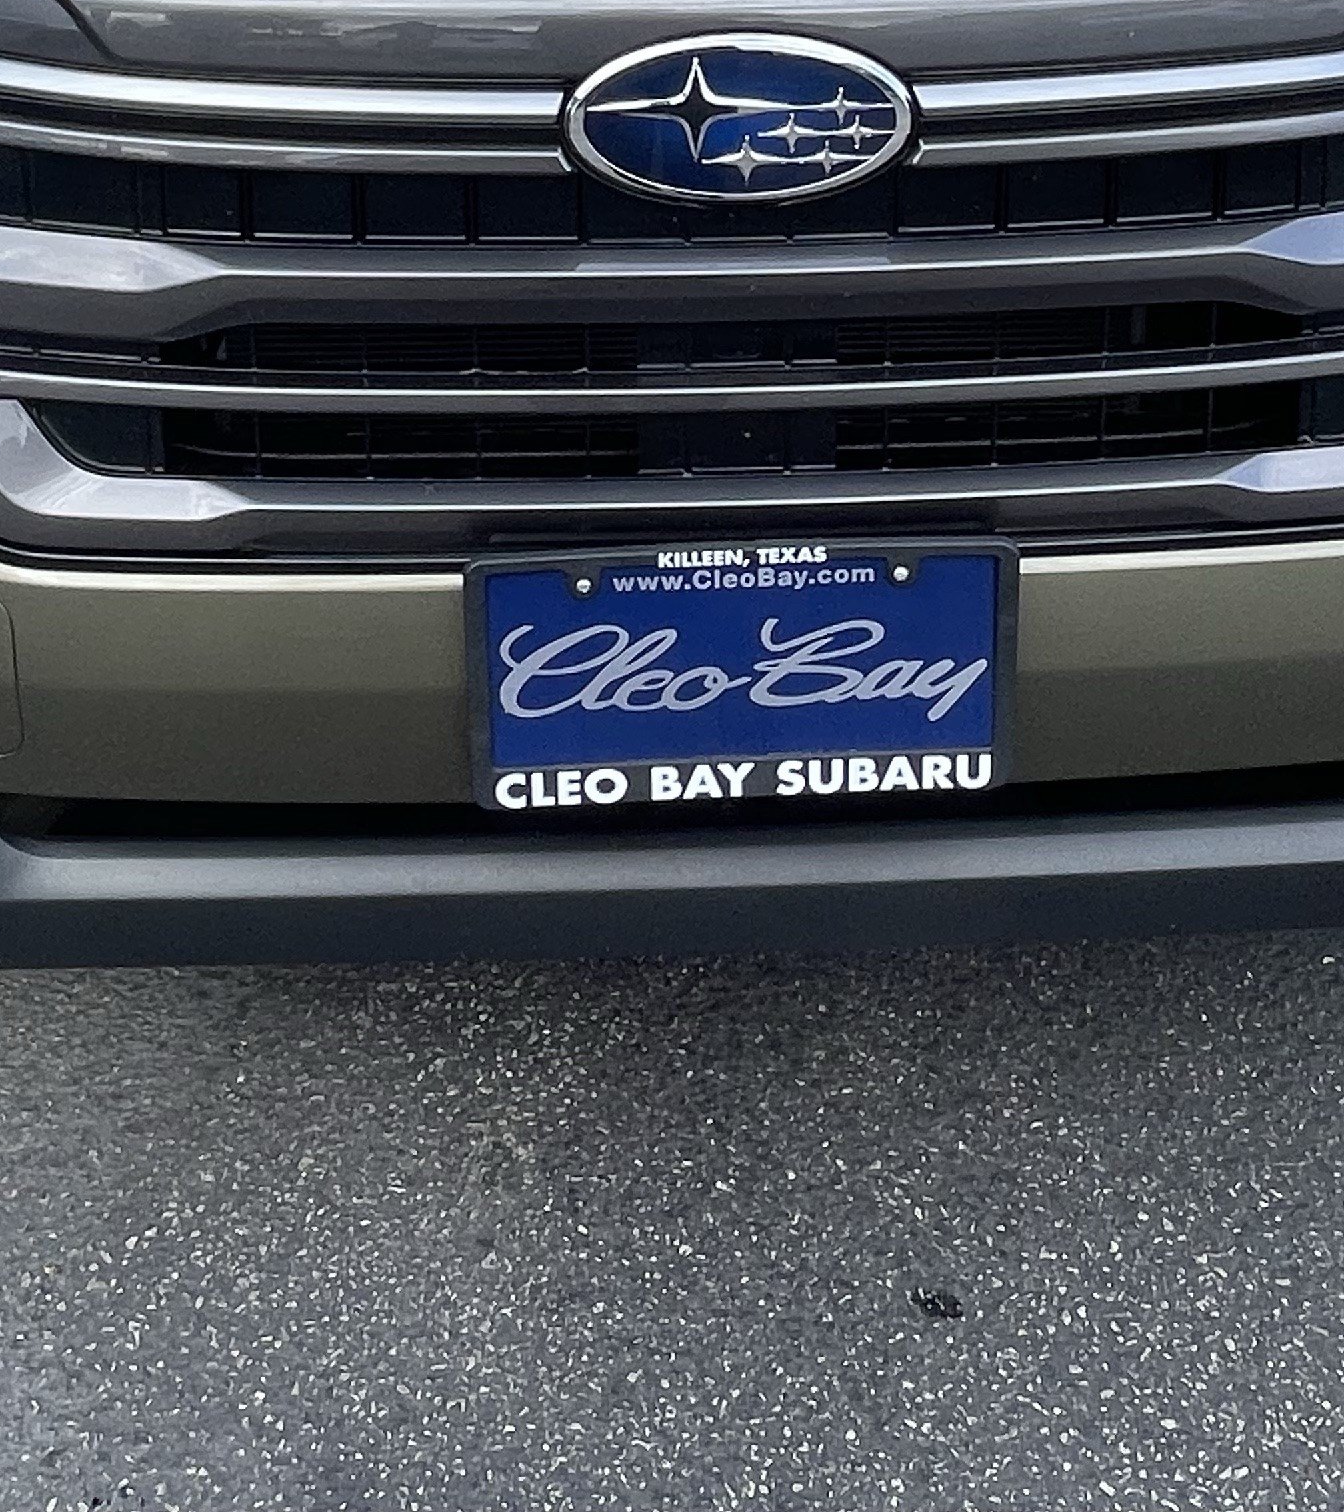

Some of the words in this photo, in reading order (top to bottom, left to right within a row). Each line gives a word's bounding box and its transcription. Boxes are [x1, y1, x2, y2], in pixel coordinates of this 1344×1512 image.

[658, 550, 752, 569] KILLEEN,
[757, 546, 827, 565] TEXAS
[612, 565, 875, 593] www.CleoBay.com
[499, 624, 751, 718] Cleo
[750, 618, 987, 722] Bay
[494, 767, 628, 809] CLEO
[651, 762, 756, 802] BAY
[775, 753, 993, 796] SUBARU
